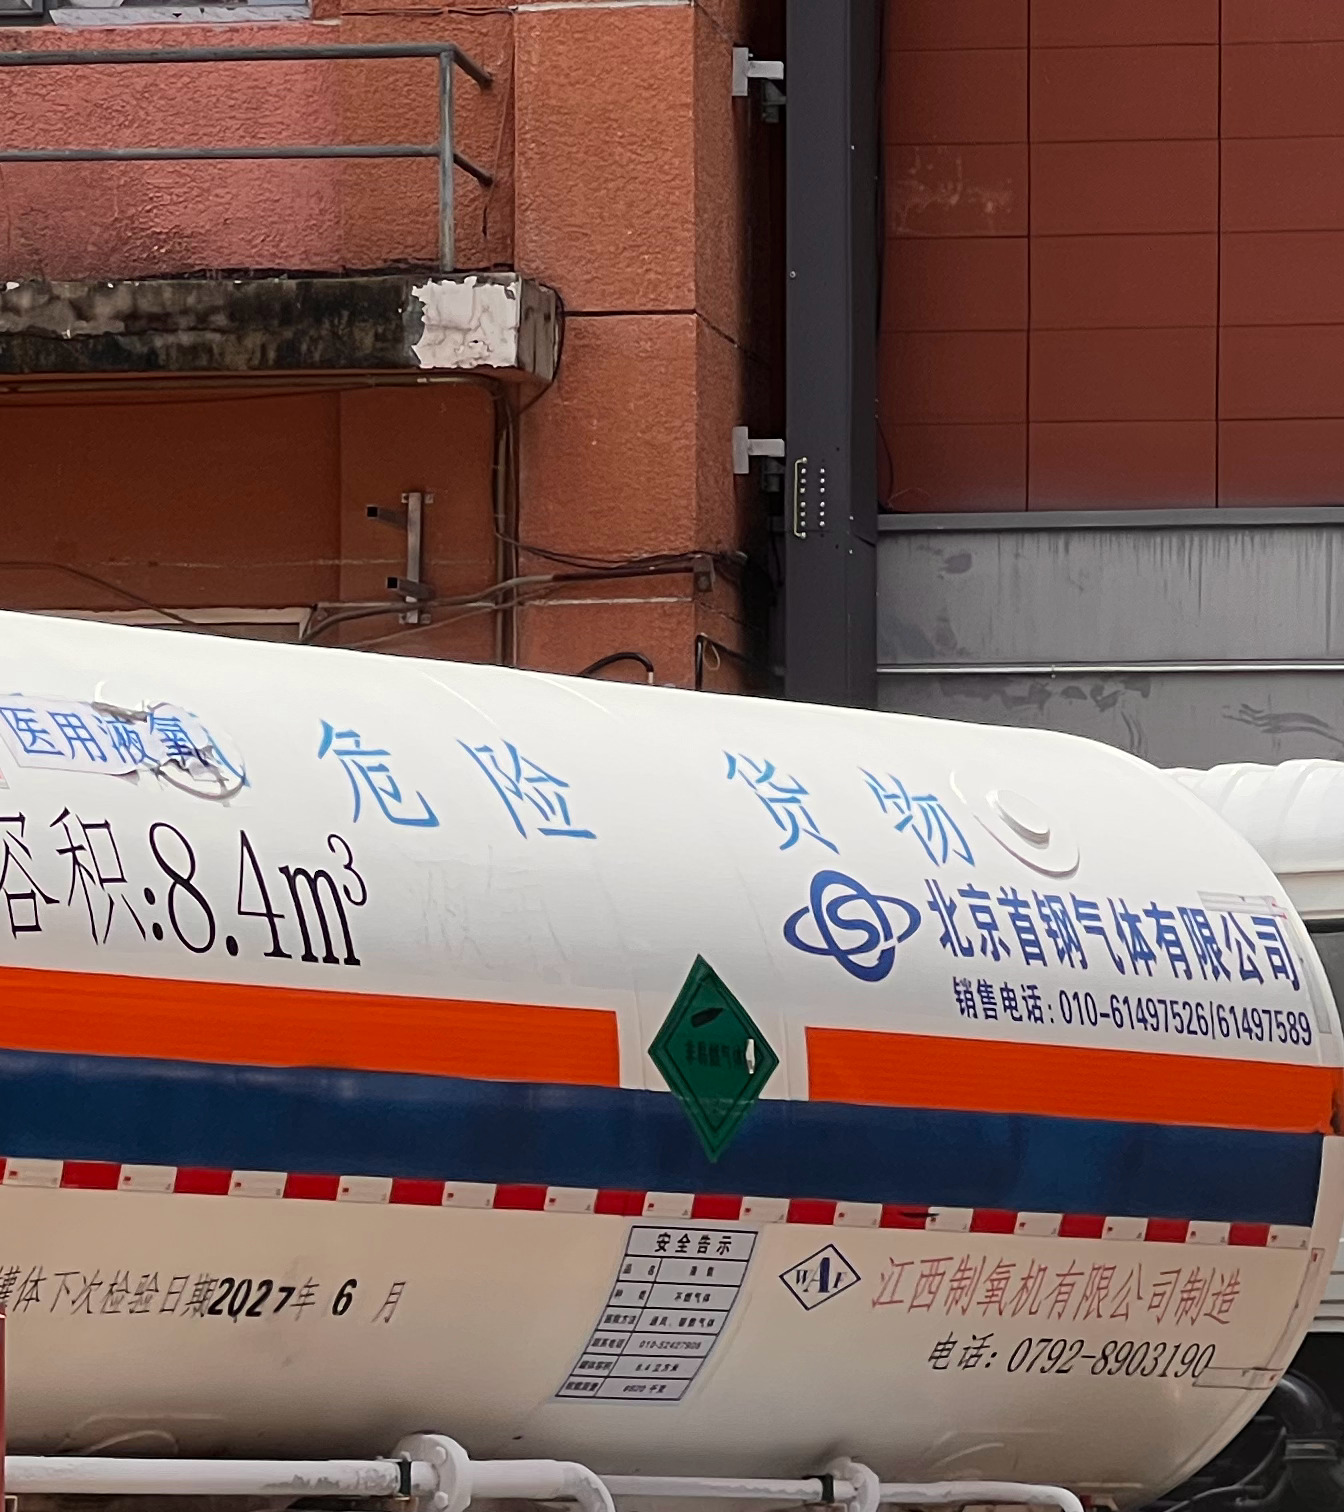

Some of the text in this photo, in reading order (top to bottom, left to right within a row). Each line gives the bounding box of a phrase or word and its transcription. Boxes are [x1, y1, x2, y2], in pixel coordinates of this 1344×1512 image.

[319, 718, 976, 868] 危险 货物
[925, 878, 1301, 992] 北京首钢气体有限公司
[655, 1232, 732, 1256] 安全告示
[872, 1254, 1242, 1326] 江西制氧机有限公司制造
